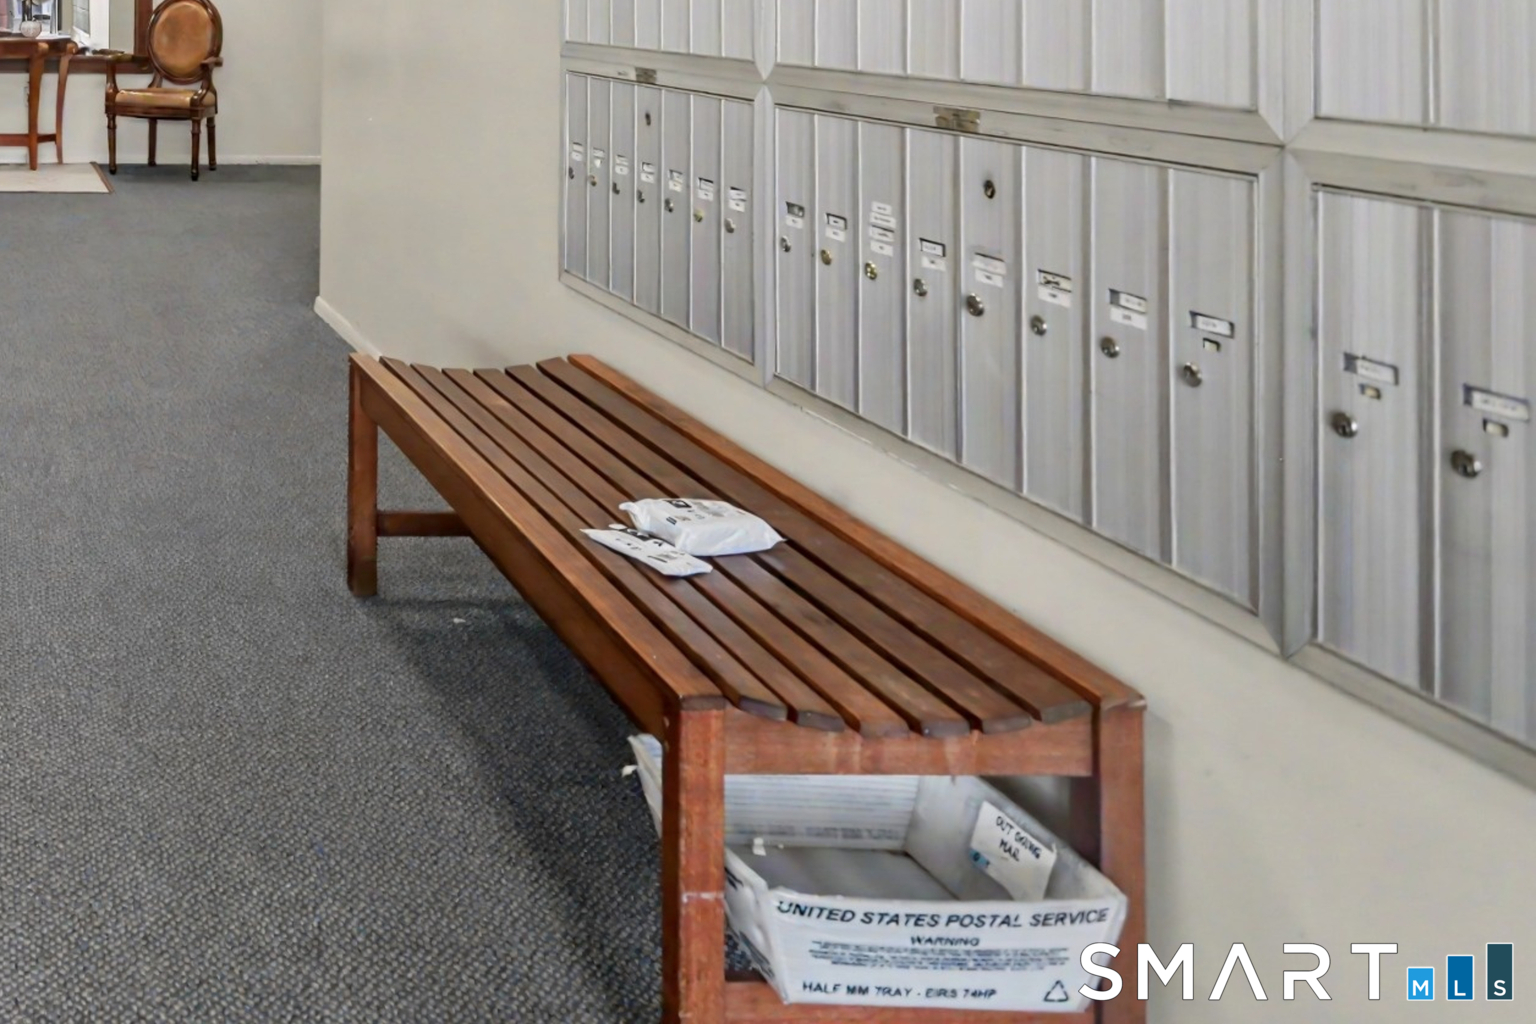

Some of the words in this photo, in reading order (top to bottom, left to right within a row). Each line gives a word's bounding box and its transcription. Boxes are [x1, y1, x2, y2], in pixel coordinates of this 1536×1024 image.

[995, 816, 1014, 835] OUT
[776, 900, 856, 923] UNITED
[860, 911, 941, 927] STATES
[945, 914, 1023, 928] POSTAL
[1029, 907, 1110, 927] SERVICE
[910, 935, 980, 947] WARNING
[802, 980, 842, 995] HALF
[874, 986, 913, 998] TRAY
